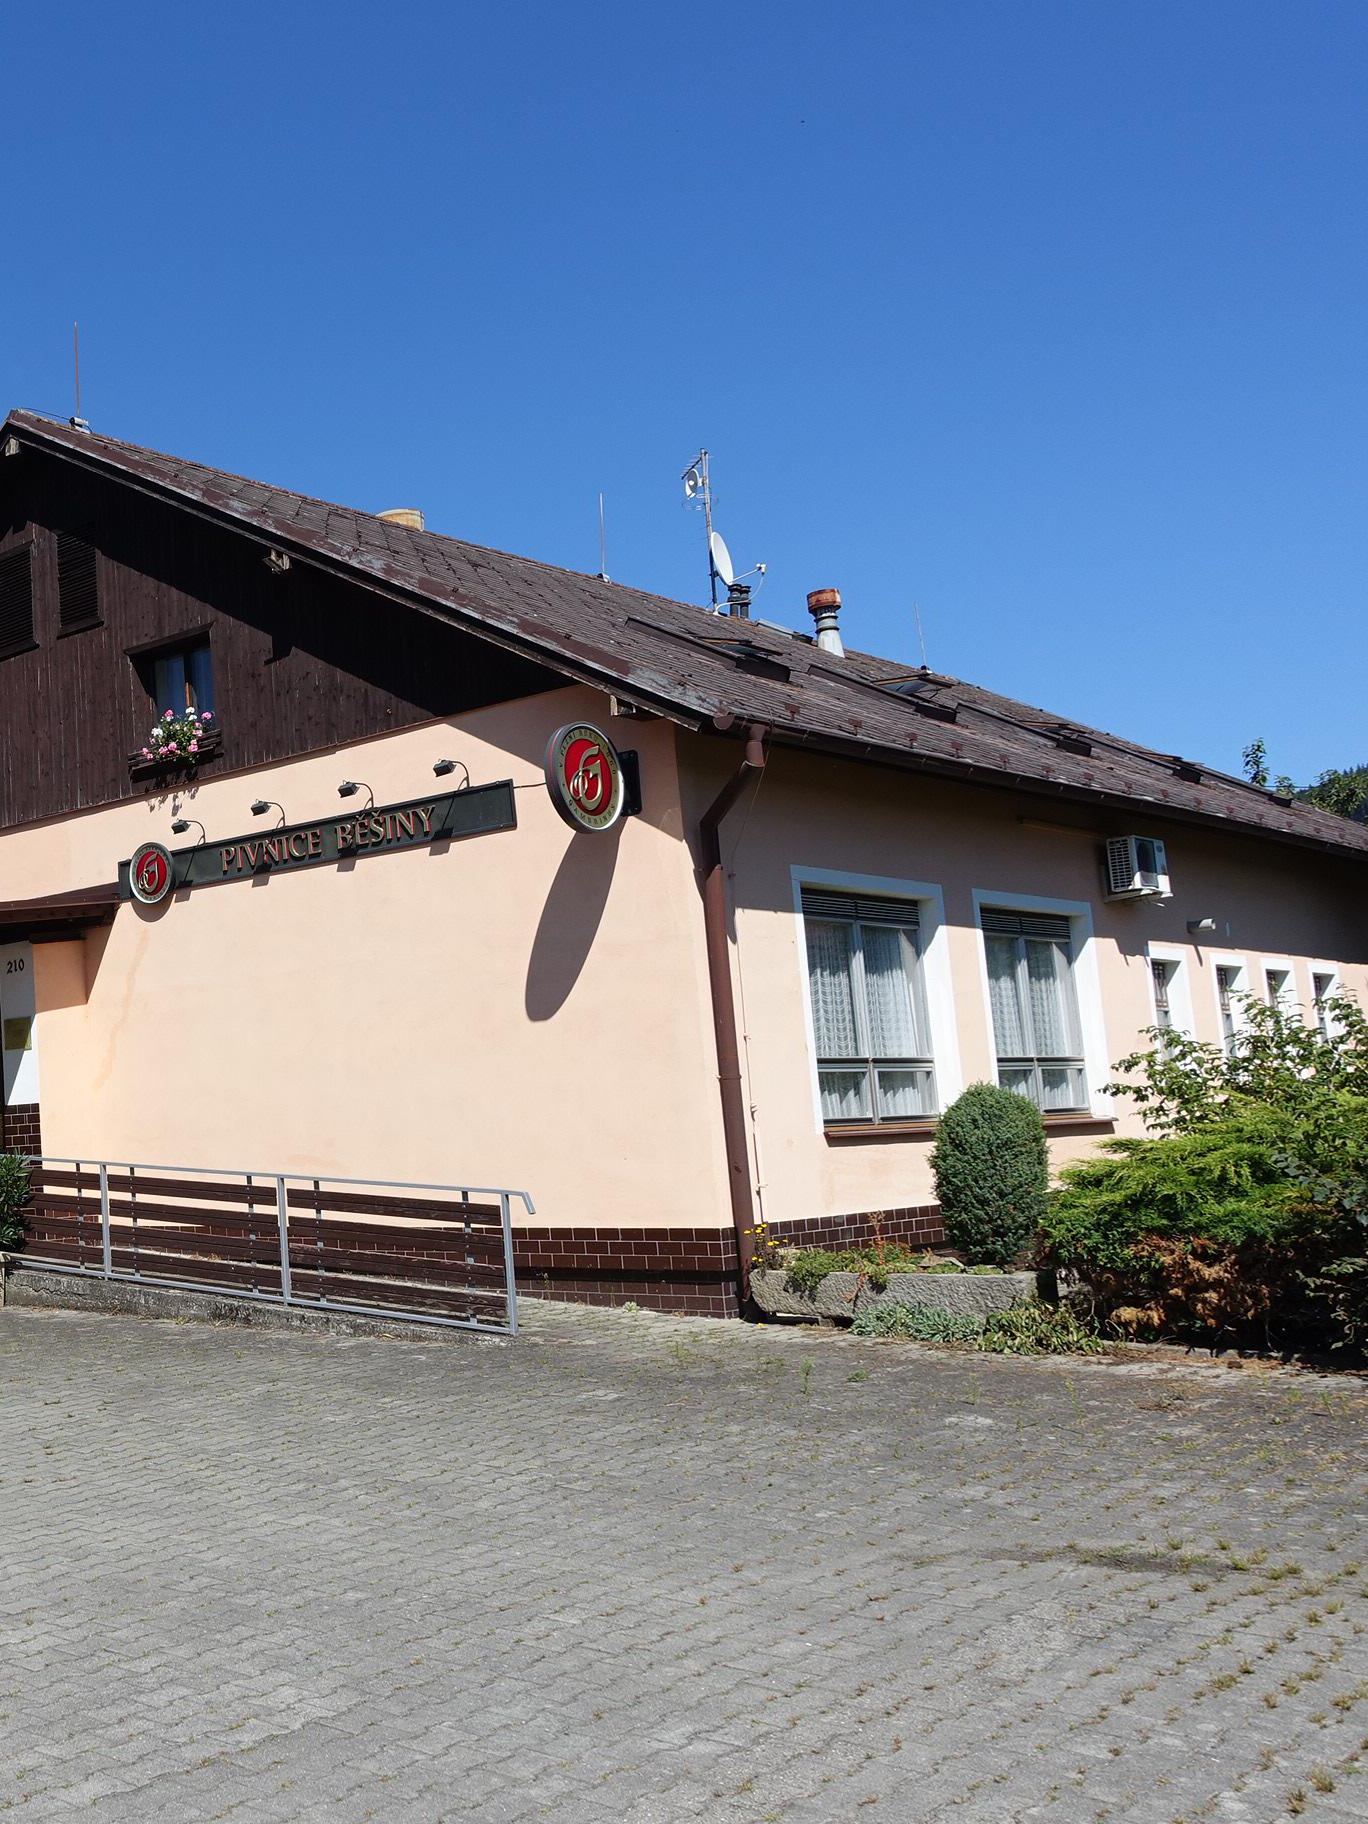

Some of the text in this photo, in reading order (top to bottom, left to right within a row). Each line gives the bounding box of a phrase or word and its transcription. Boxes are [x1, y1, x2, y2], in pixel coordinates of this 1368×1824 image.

[219, 805, 435, 873] PIVNICE BĚŠINY
[6, 958, 25, 974] 210
